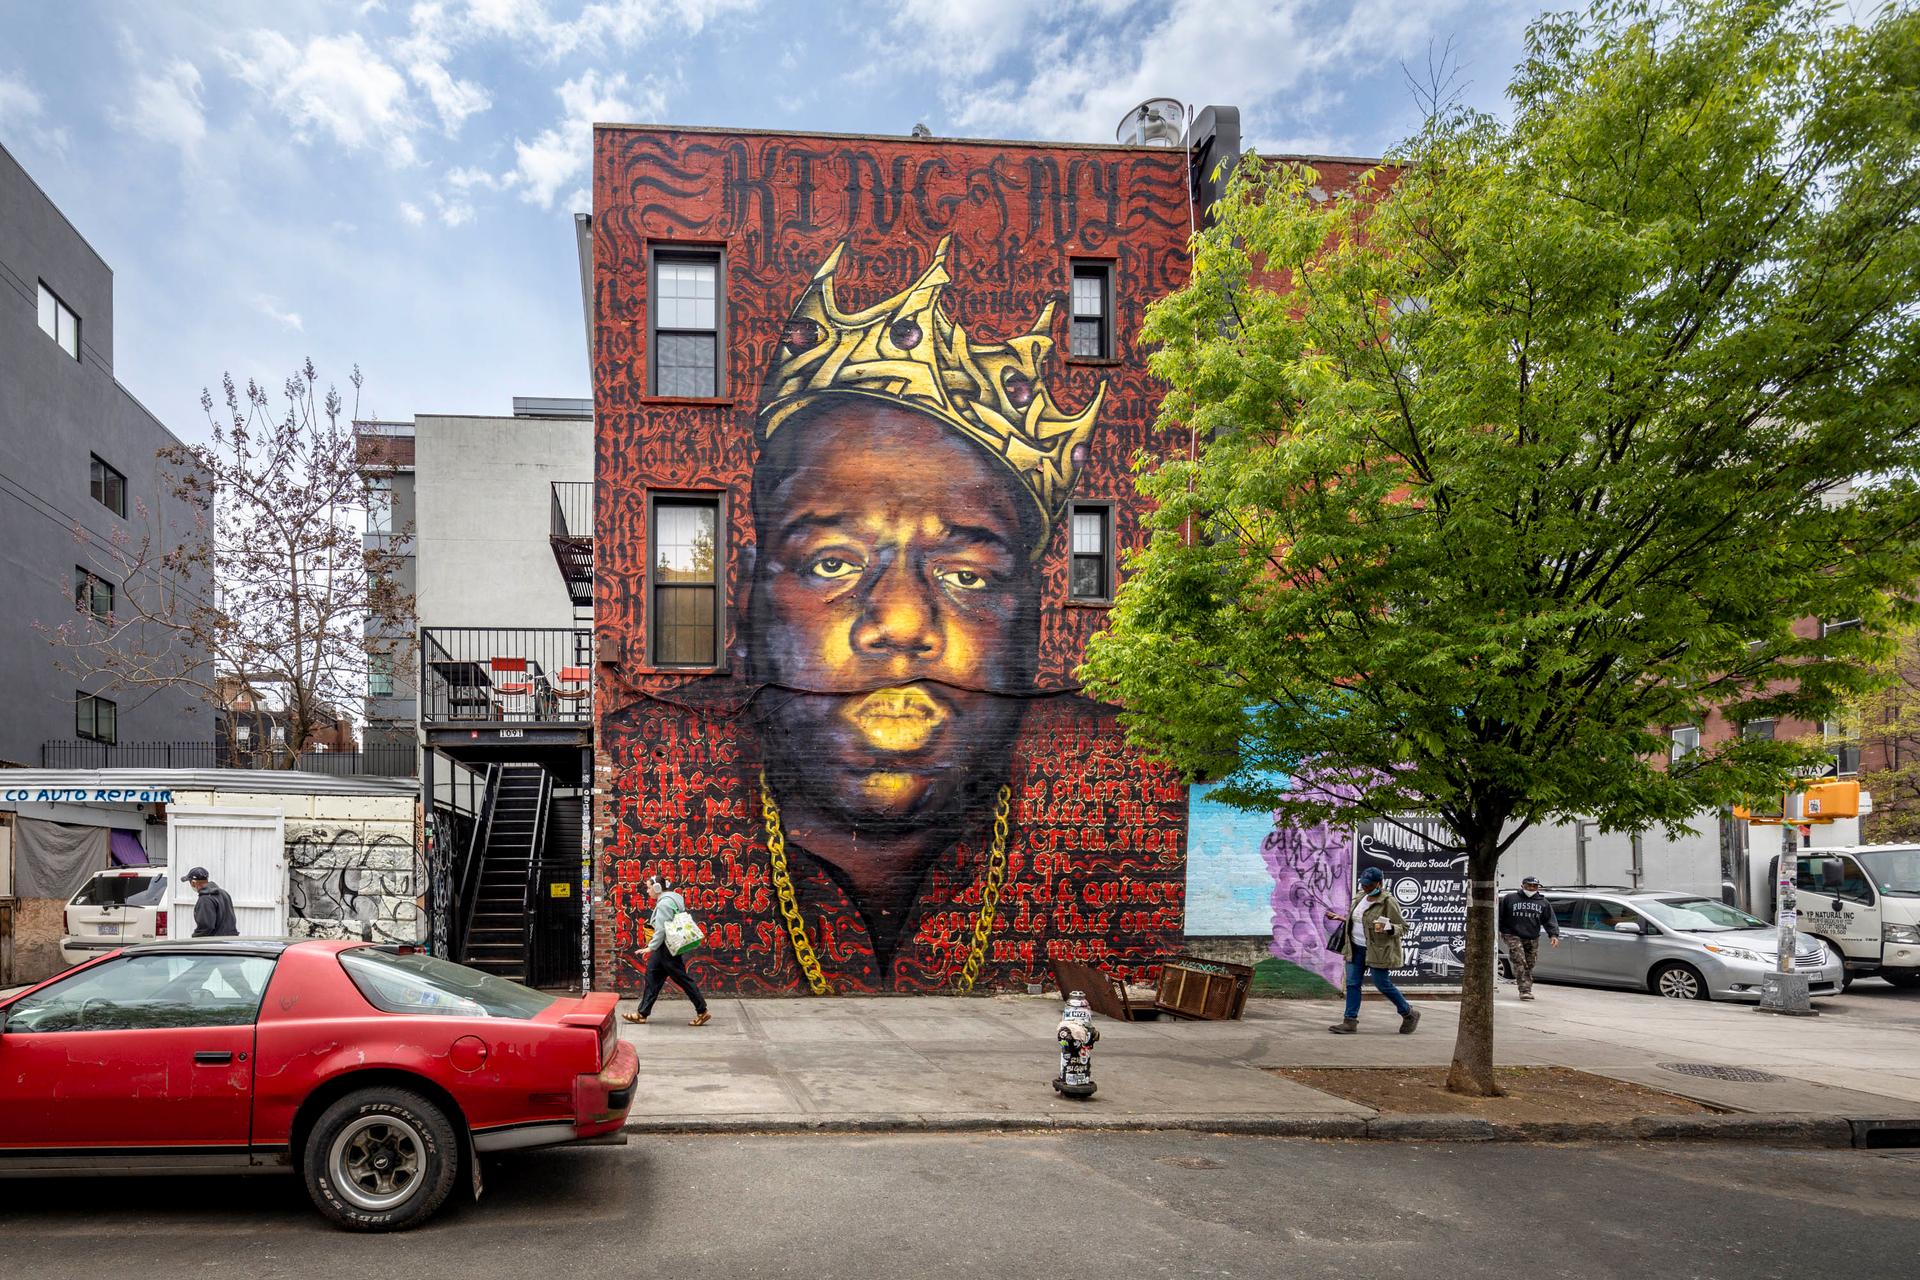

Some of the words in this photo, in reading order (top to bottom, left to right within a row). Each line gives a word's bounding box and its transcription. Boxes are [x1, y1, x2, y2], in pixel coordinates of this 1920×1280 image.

[500, 729, 523, 738] 1091
[1016, 752, 1125, 778] rothers
[1801, 765, 1824, 776] WAY
[1053, 773, 1133, 802] others
[37, 790, 87, 801] AUTO
[1030, 827, 1108, 853] crew
[721, 852, 771, 887] hea
[1396, 859, 1427, 870] Organic
[1429, 859, 1450, 868] Food
[920, 864, 1053, 905] Bedord
[1423, 880, 1453, 893] JUST
[1513, 902, 1543, 914] RUSSELL
[1815, 911, 1842, 919] NATURAL
[1423, 922, 1445, 932] FROM
[1447, 922, 1461, 932] THE
